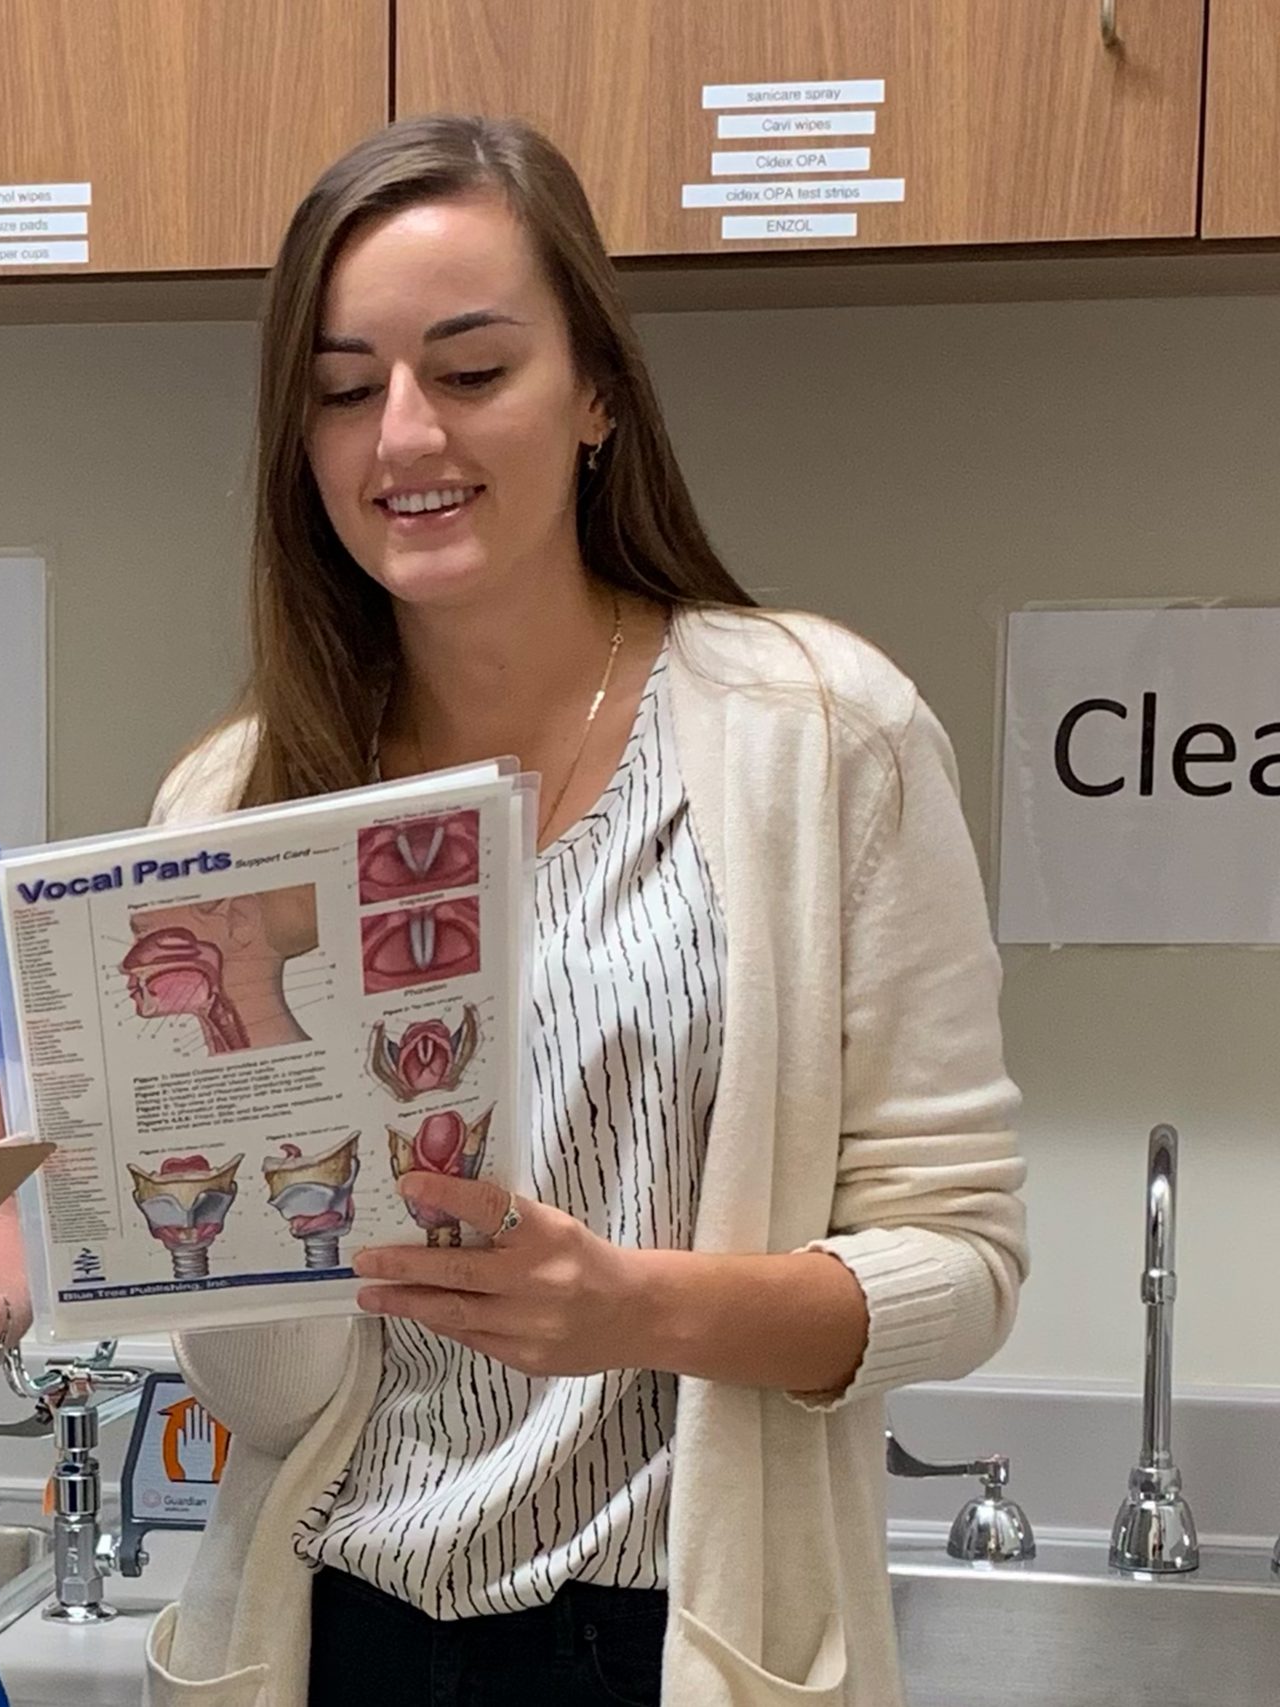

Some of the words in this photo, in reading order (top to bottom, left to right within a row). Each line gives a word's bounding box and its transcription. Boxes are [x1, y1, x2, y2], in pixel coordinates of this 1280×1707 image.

[747, 89, 801, 102] sanicare
[806, 87, 842, 101] spray
[762, 119, 791, 132] Cavi
[795, 118, 832, 132] wipes
[756, 154, 793, 168] Cidex
[796, 153, 827, 167] OPA
[18, 191, 52, 203] wipes
[726, 187, 760, 202] cidex
[763, 187, 793, 200] OPA
[797, 186, 821, 199] test
[825, 184, 860, 199] strips
[20, 219, 48, 232] pads
[766, 219, 813, 232] ENZOL
[21, 248, 49, 260] cups
[1054, 692, 1280, 798] Clea
[17, 866, 124, 905] Vocal
[133, 850, 233, 886] Parts
[283, 847, 311, 860] Card
[63, 1291, 94, 1302] Blue
[97, 1288, 127, 1298] Tree
